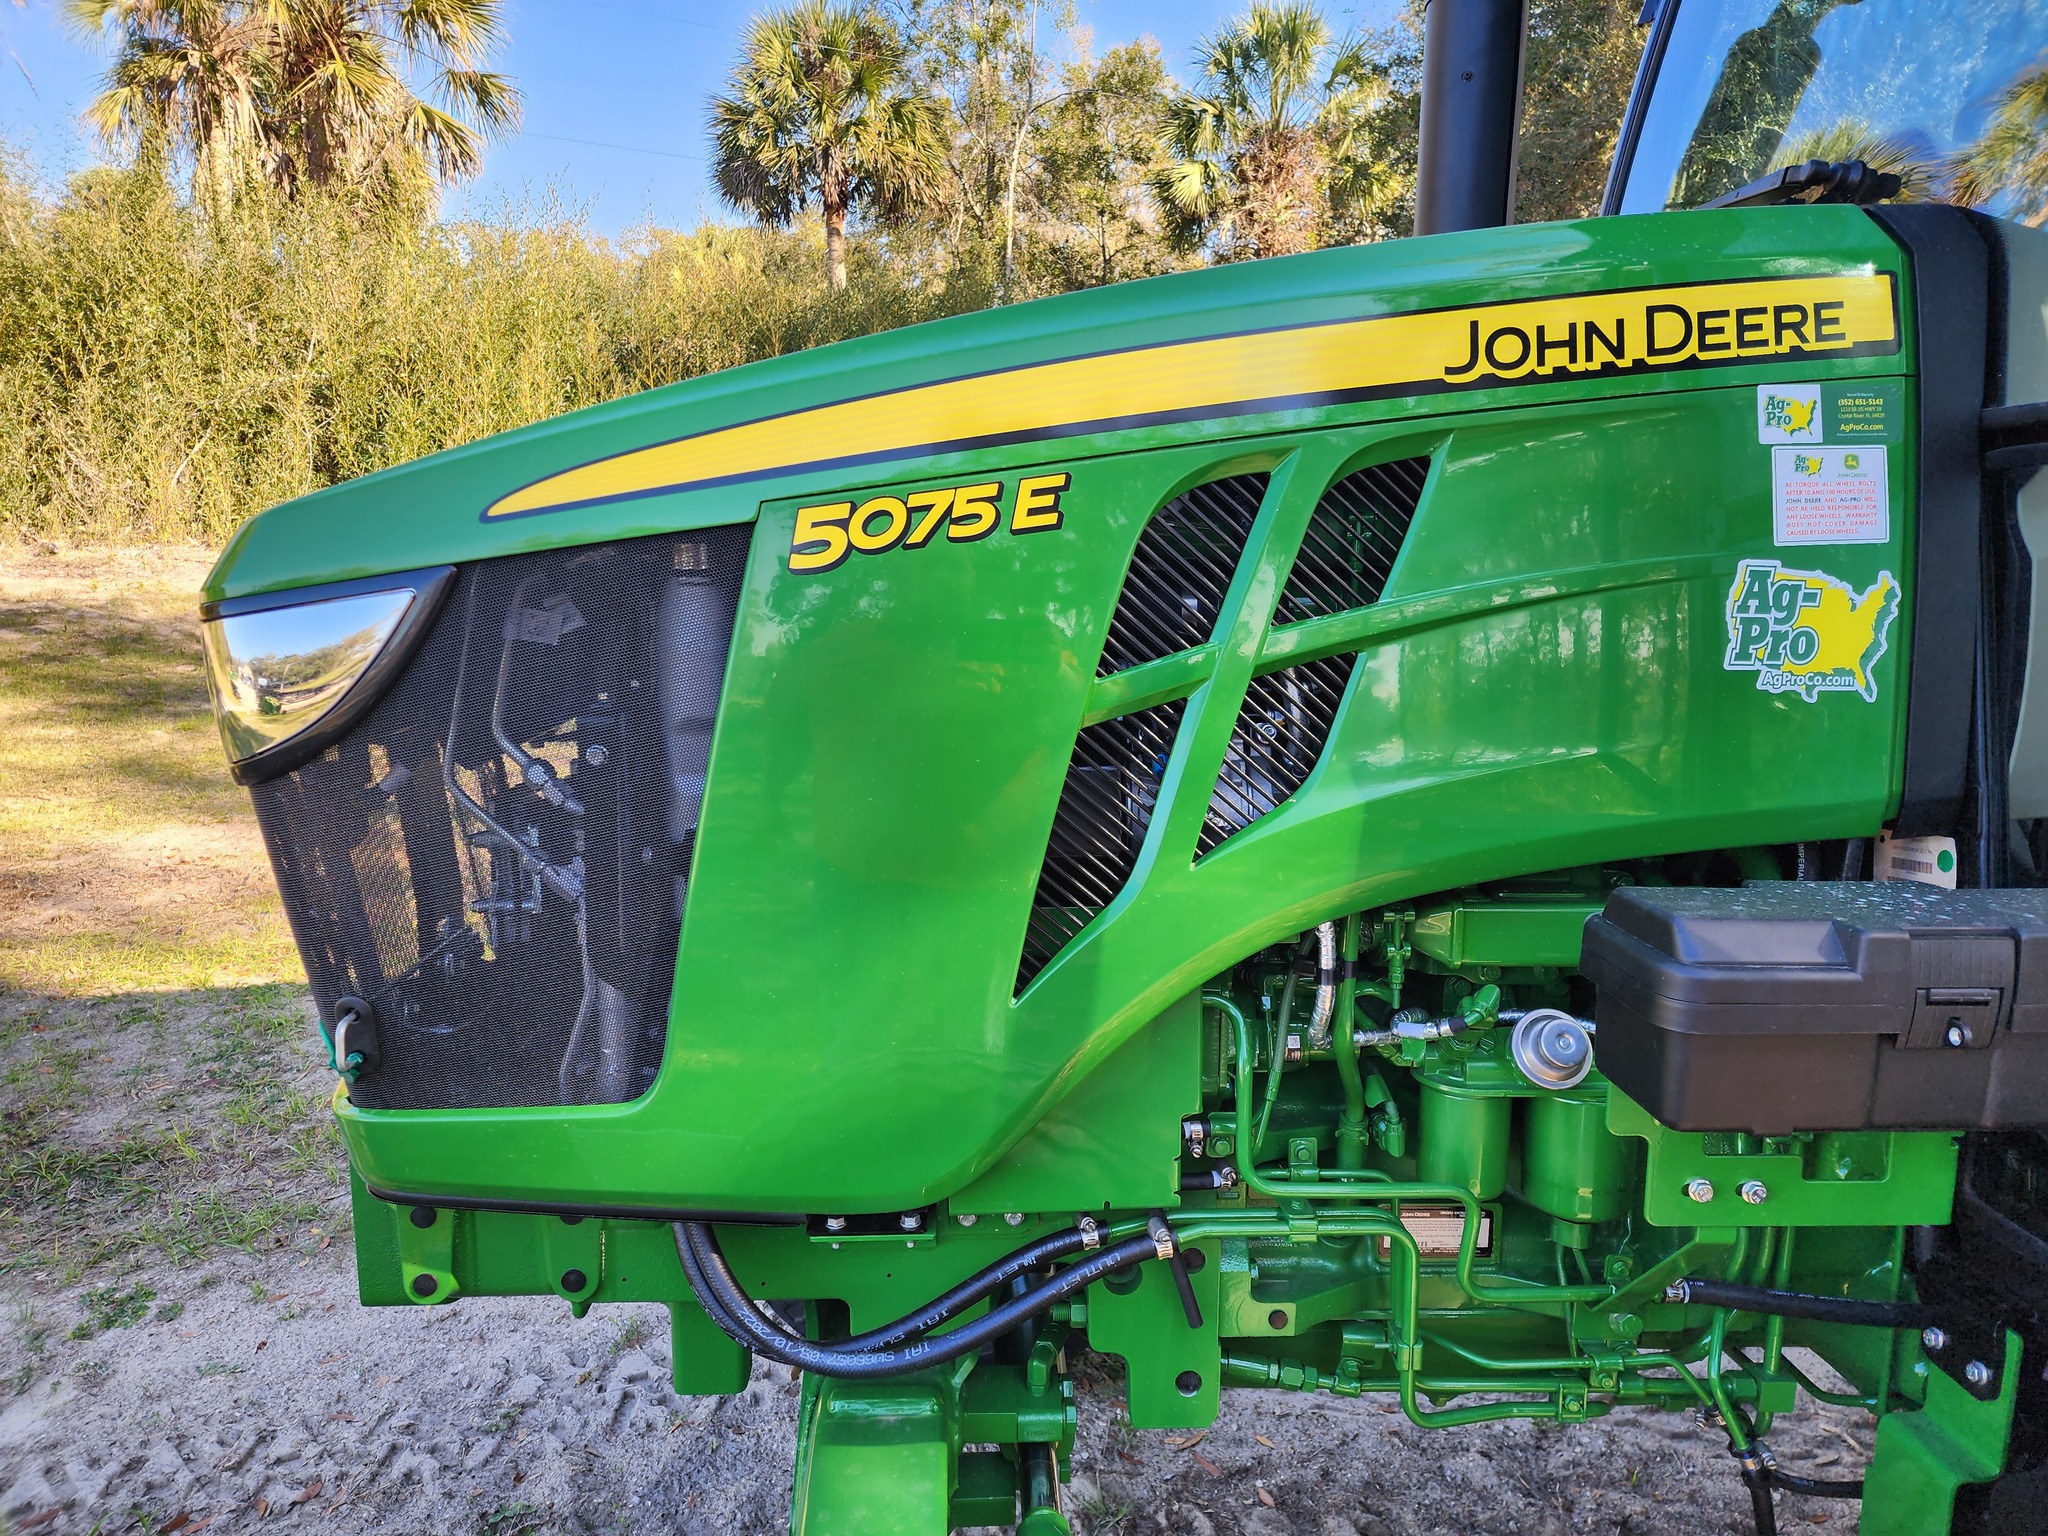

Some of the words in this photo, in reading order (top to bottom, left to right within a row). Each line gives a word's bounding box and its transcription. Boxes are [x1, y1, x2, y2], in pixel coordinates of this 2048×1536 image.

[1444, 319, 1625, 376] JOHN
[1645, 301, 1846, 358] DEERE
[1765, 412, 1792, 426] Pro
[1840, 424, 1883, 432] AgProCo.com
[1795, 464, 1810, 472] Pro
[787, 480, 1004, 575] 5075
[1010, 472, 1072, 536] E
[1732, 565, 1822, 627] Ag-
[1729, 616, 1819, 667] Pro
[1762, 671, 1856, 688] AgProCo.com
[995, 1256, 1037, 1283] INLET
[1061, 1253, 1121, 1293] OUTLET
